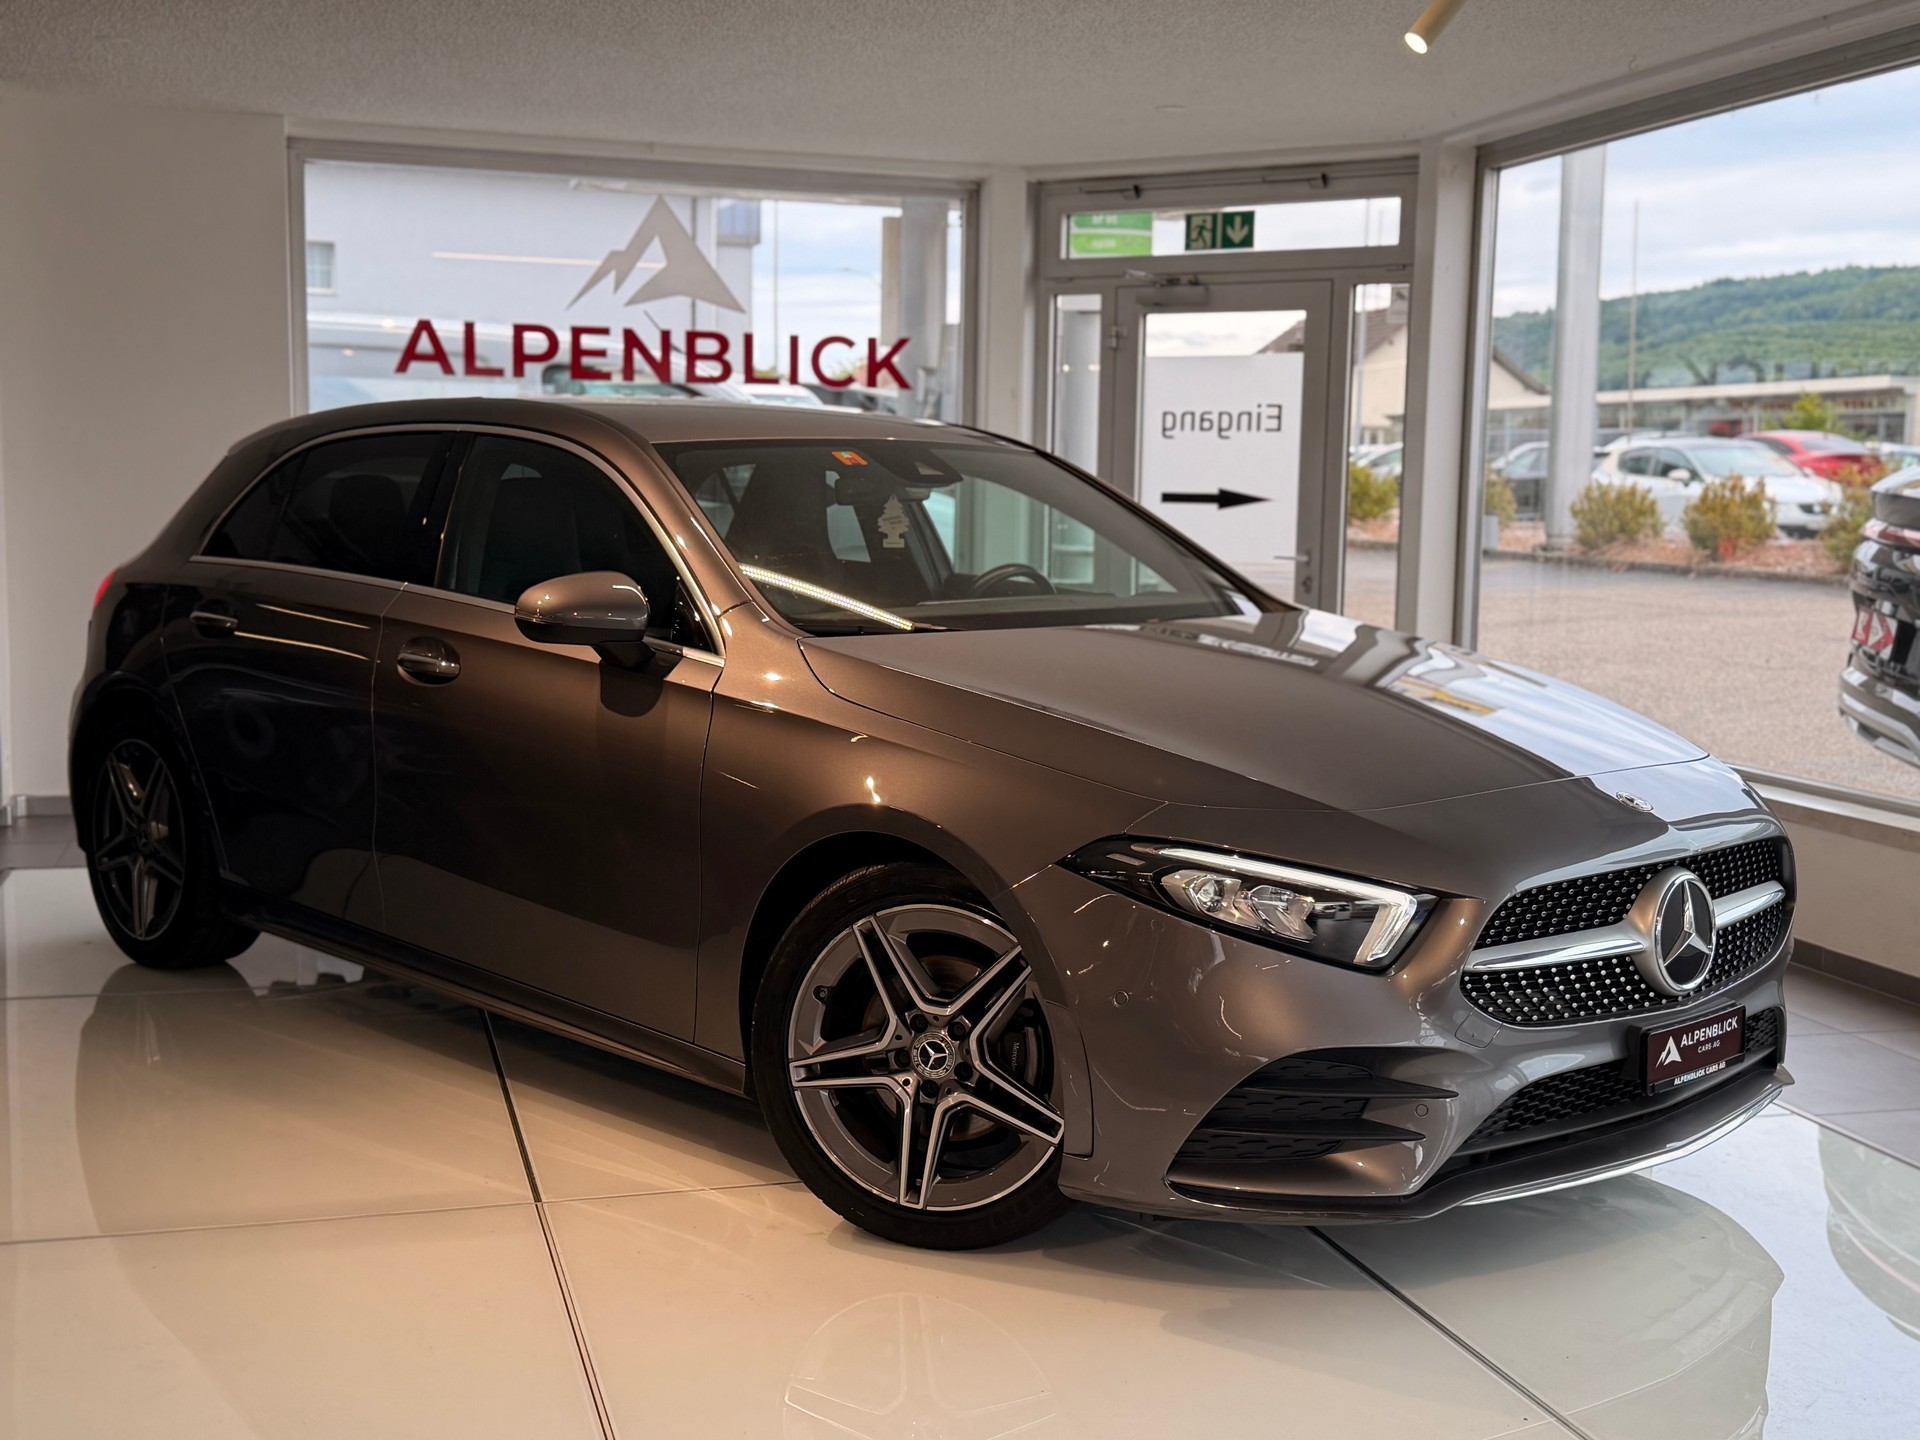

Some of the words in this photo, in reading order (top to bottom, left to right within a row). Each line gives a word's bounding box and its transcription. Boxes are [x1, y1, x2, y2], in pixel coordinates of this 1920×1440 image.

[394, 319, 912, 390] ALPENBLICK
[1680, 1016, 1738, 1048] ALPENBLICK
[1697, 1042, 1712, 1053] CARS
[1713, 1039, 1721, 1048] AG
[1673, 1068, 1705, 1086] ALPENBLICK
[1705, 1063, 1719, 1075] CARS
[1719, 1061, 1726, 1070] AG
